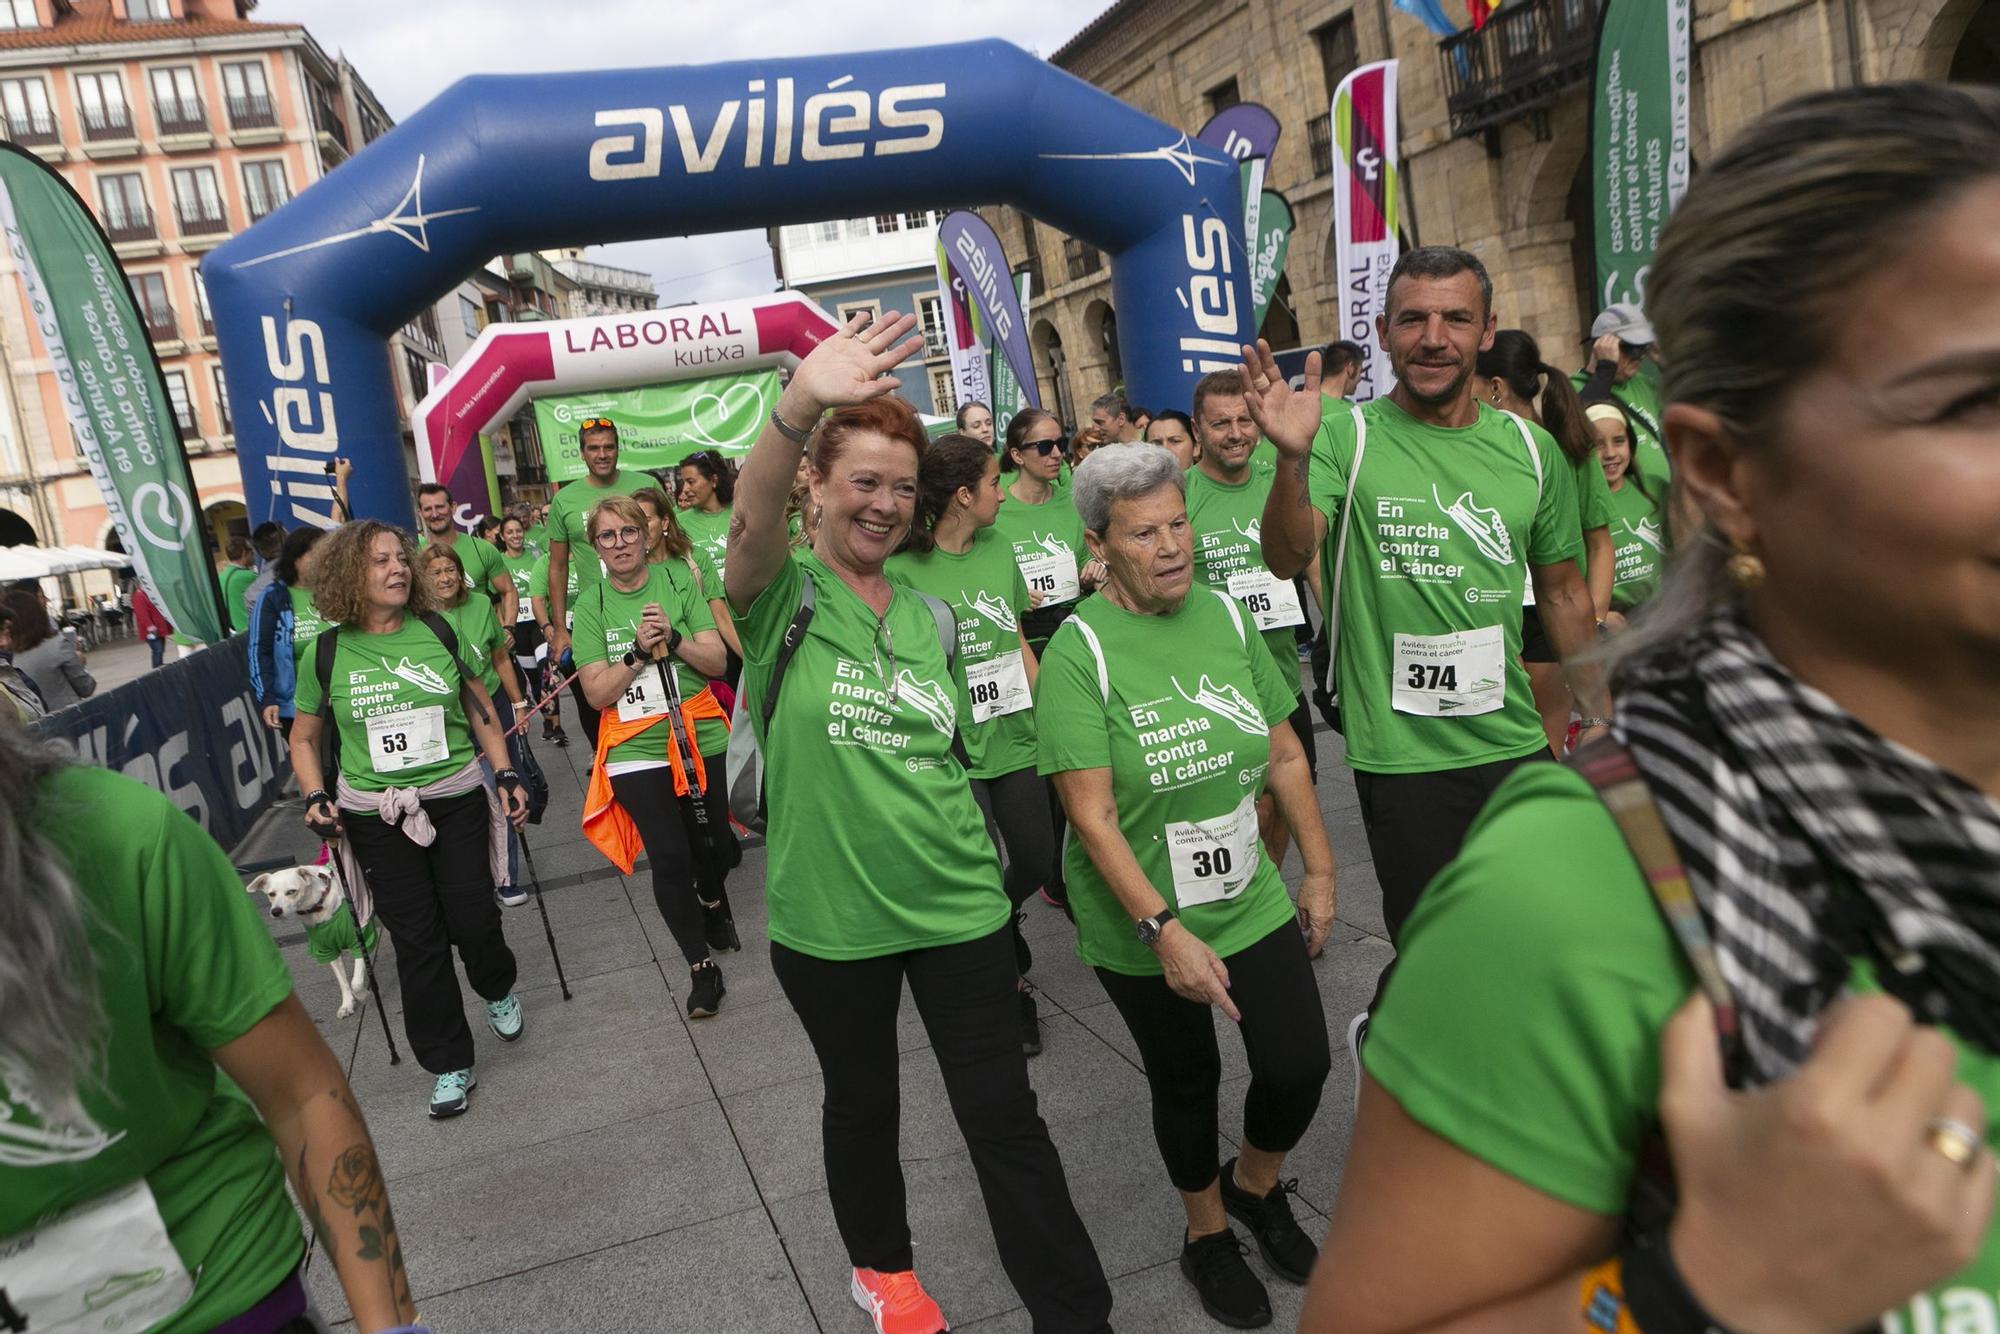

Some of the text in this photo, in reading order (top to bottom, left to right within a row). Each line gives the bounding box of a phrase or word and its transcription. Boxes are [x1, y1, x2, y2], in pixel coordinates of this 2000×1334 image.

[588, 74, 947, 183] avilés
[1624, 89, 1643, 252] contra el cáncer
[1645, 137, 1661, 222] Asturias
[565, 311, 742, 354] LABORAL
[674, 343, 745, 368] kutxa
[631, 433, 682, 449] cáncer
[1377, 501, 1404, 518] En
[1378, 522, 1449, 540] marcha
[1202, 536, 1220, 548] En
[1205, 543, 1250, 559] marcha
[1379, 541, 1440, 558] contra
[1207, 556, 1246, 570] contra
[1380, 556, 1464, 578] el cáncer
[1031, 575, 1055, 591] 715
[1208, 570, 1220, 581] el
[606, 632, 619, 642] En
[1401, 640, 1426, 649] Avilés
[961, 640, 993, 655] áncer
[1401, 648, 1427, 657] contra
[350, 673, 367, 685] En
[836, 661, 864, 680] En
[1407, 663, 1457, 691] 374
[351, 680, 400, 696] marcha
[625, 685, 645, 705] 54
[969, 681, 999, 705] 188
[351, 693, 394, 707] contra
[352, 701, 414, 719] el cáncer
[829, 701, 893, 726] contra
[1130, 708, 1160, 728] En
[828, 719, 846, 737] el
[852, 725, 911, 748] cáncer
[1138, 716, 1211, 747] marcha
[382, 732, 408, 754] 53
[1144, 739, 1207, 767] contra
[1150, 766, 1169, 786] el
[1175, 751, 1235, 780] cáncer
[1174, 826, 1201, 838] Avilés
[1175, 835, 1203, 846] contra
[1192, 847, 1232, 878] 30
